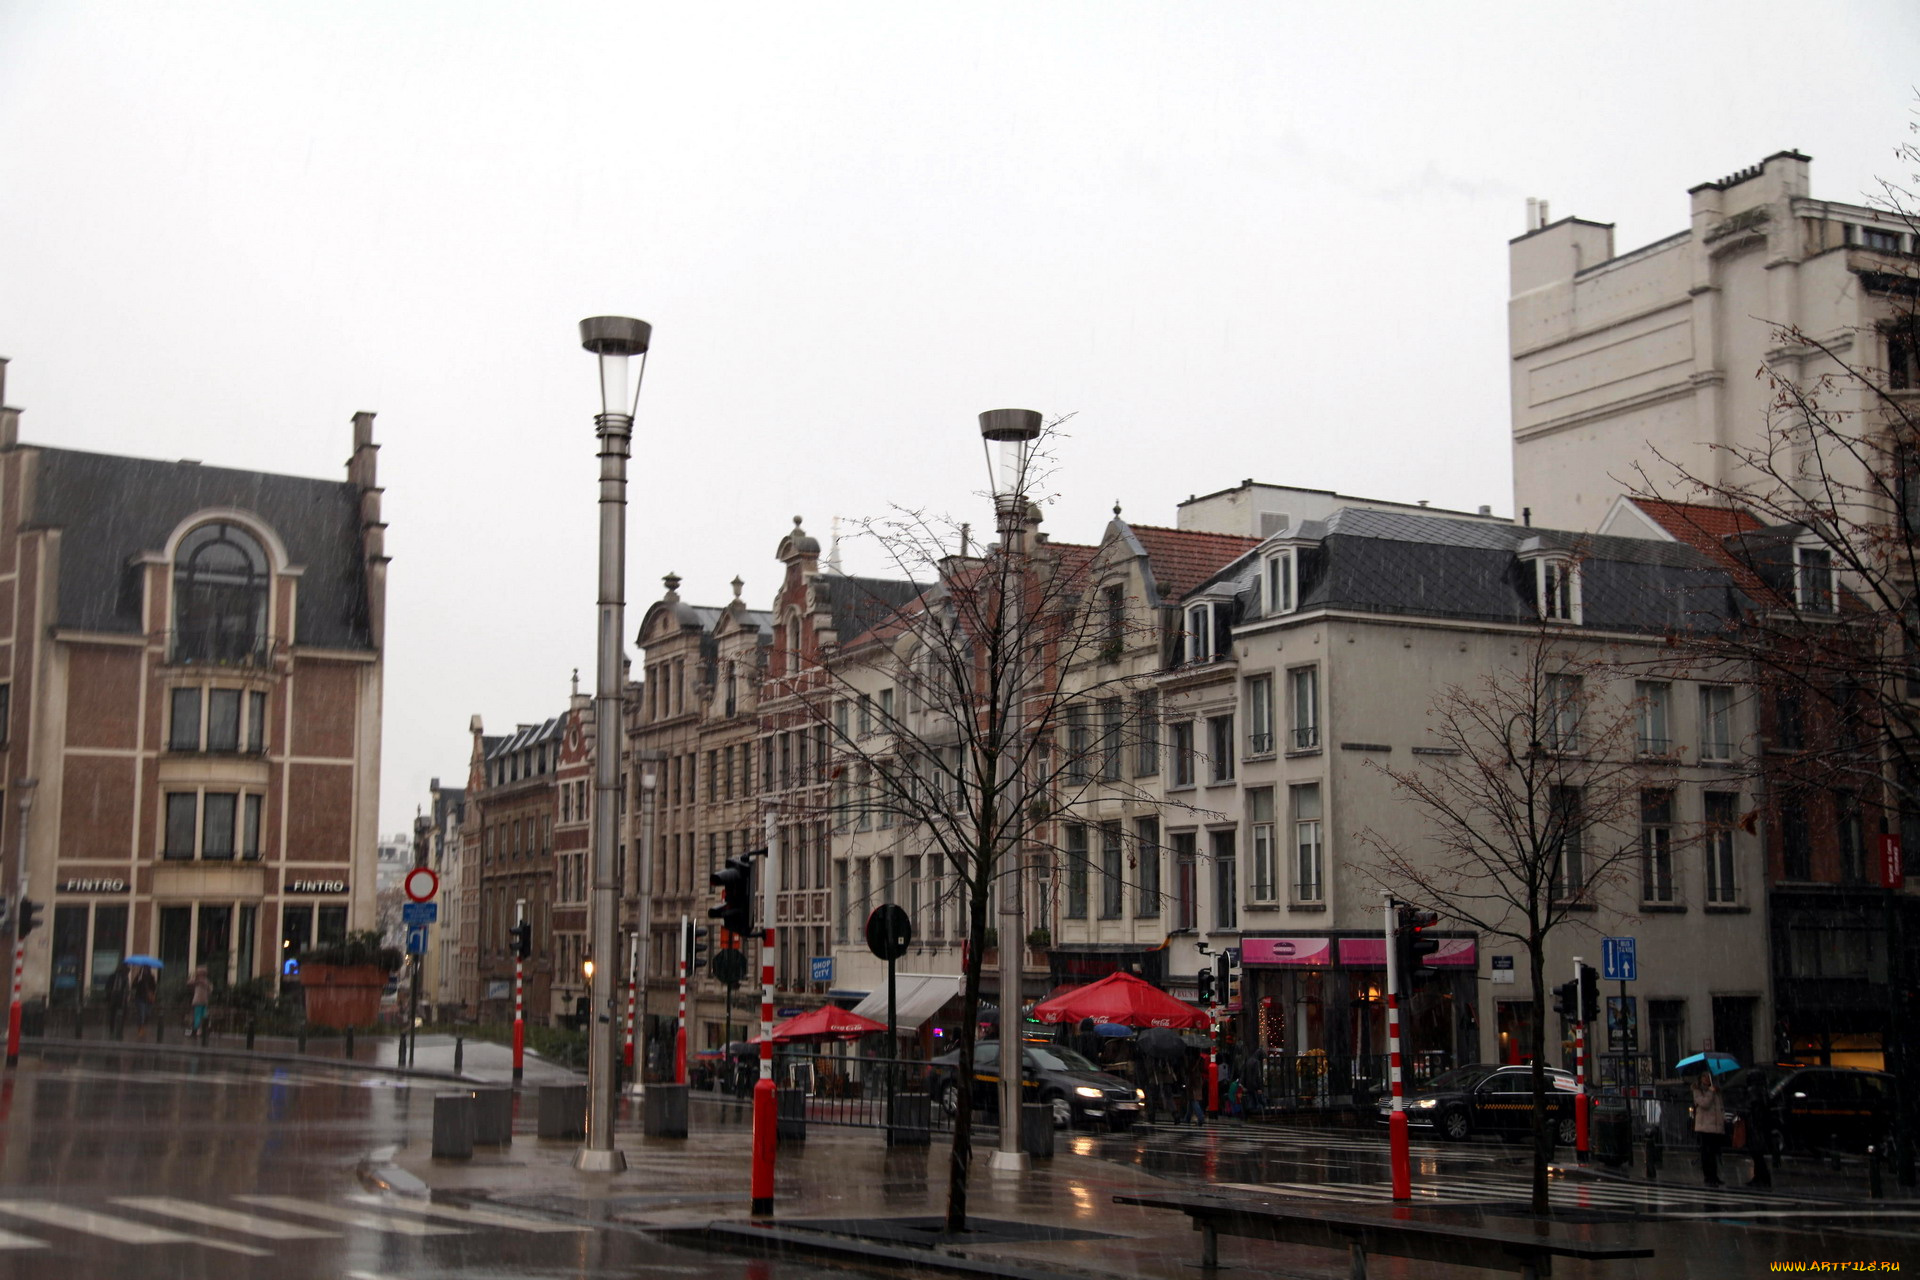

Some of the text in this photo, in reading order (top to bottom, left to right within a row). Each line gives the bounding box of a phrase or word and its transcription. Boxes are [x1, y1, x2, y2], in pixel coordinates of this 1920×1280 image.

[66, 877, 124, 892] FINTRO
[294, 879, 344, 892] FINTRO
[812, 959, 831, 970] SHOP
[814, 968, 829, 979] CITY
